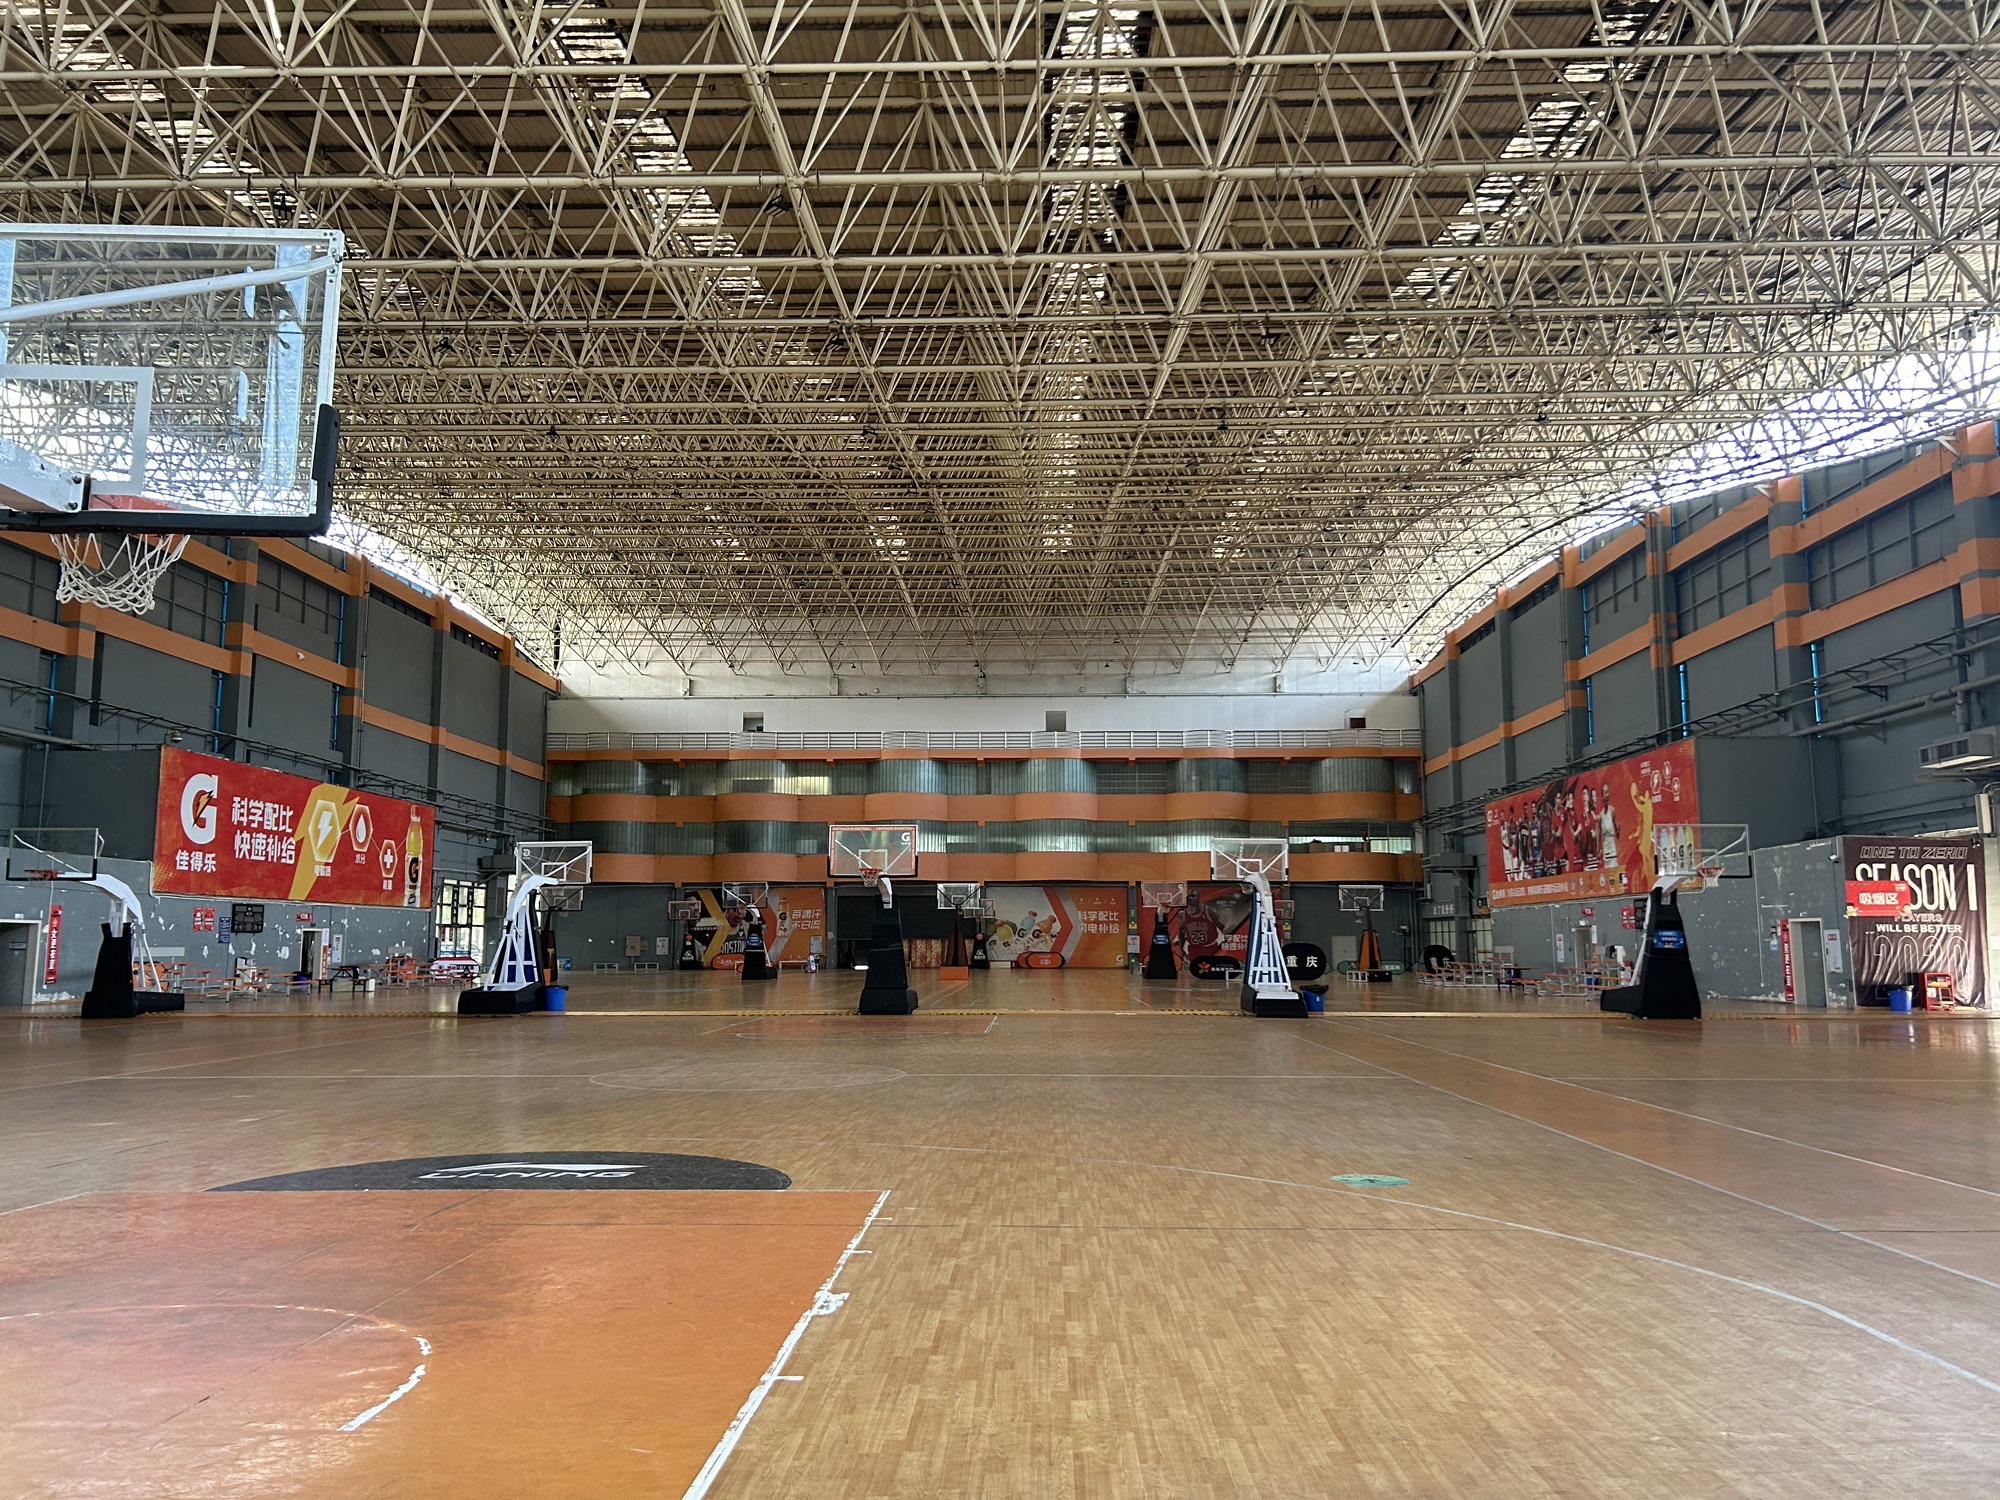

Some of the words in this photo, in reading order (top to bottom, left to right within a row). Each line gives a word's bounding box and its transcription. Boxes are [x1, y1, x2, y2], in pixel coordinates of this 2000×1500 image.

[181, 773, 218, 845] G
[231, 796, 293, 833] 科学配比
[901, 832, 911, 842] G
[233, 829, 296, 865] 快速补给
[1860, 846, 1896, 859] ONE
[1899, 846, 1920, 859] TO
[1921, 846, 1968, 860] ZERO
[175, 849, 217, 873] 佳得乐
[1859, 892, 1898, 905] 吸烟区
[1077, 910, 1119, 921] 科学配比
[1077, 923, 1119, 934] 闪电补给
[1876, 924, 1903, 933] WILL
[1904, 924, 1918, 933] BE
[1920, 924, 1963, 933] BETTER
[1189, 931, 1208, 945] 23
[1286, 955, 1318, 968] 重庆
